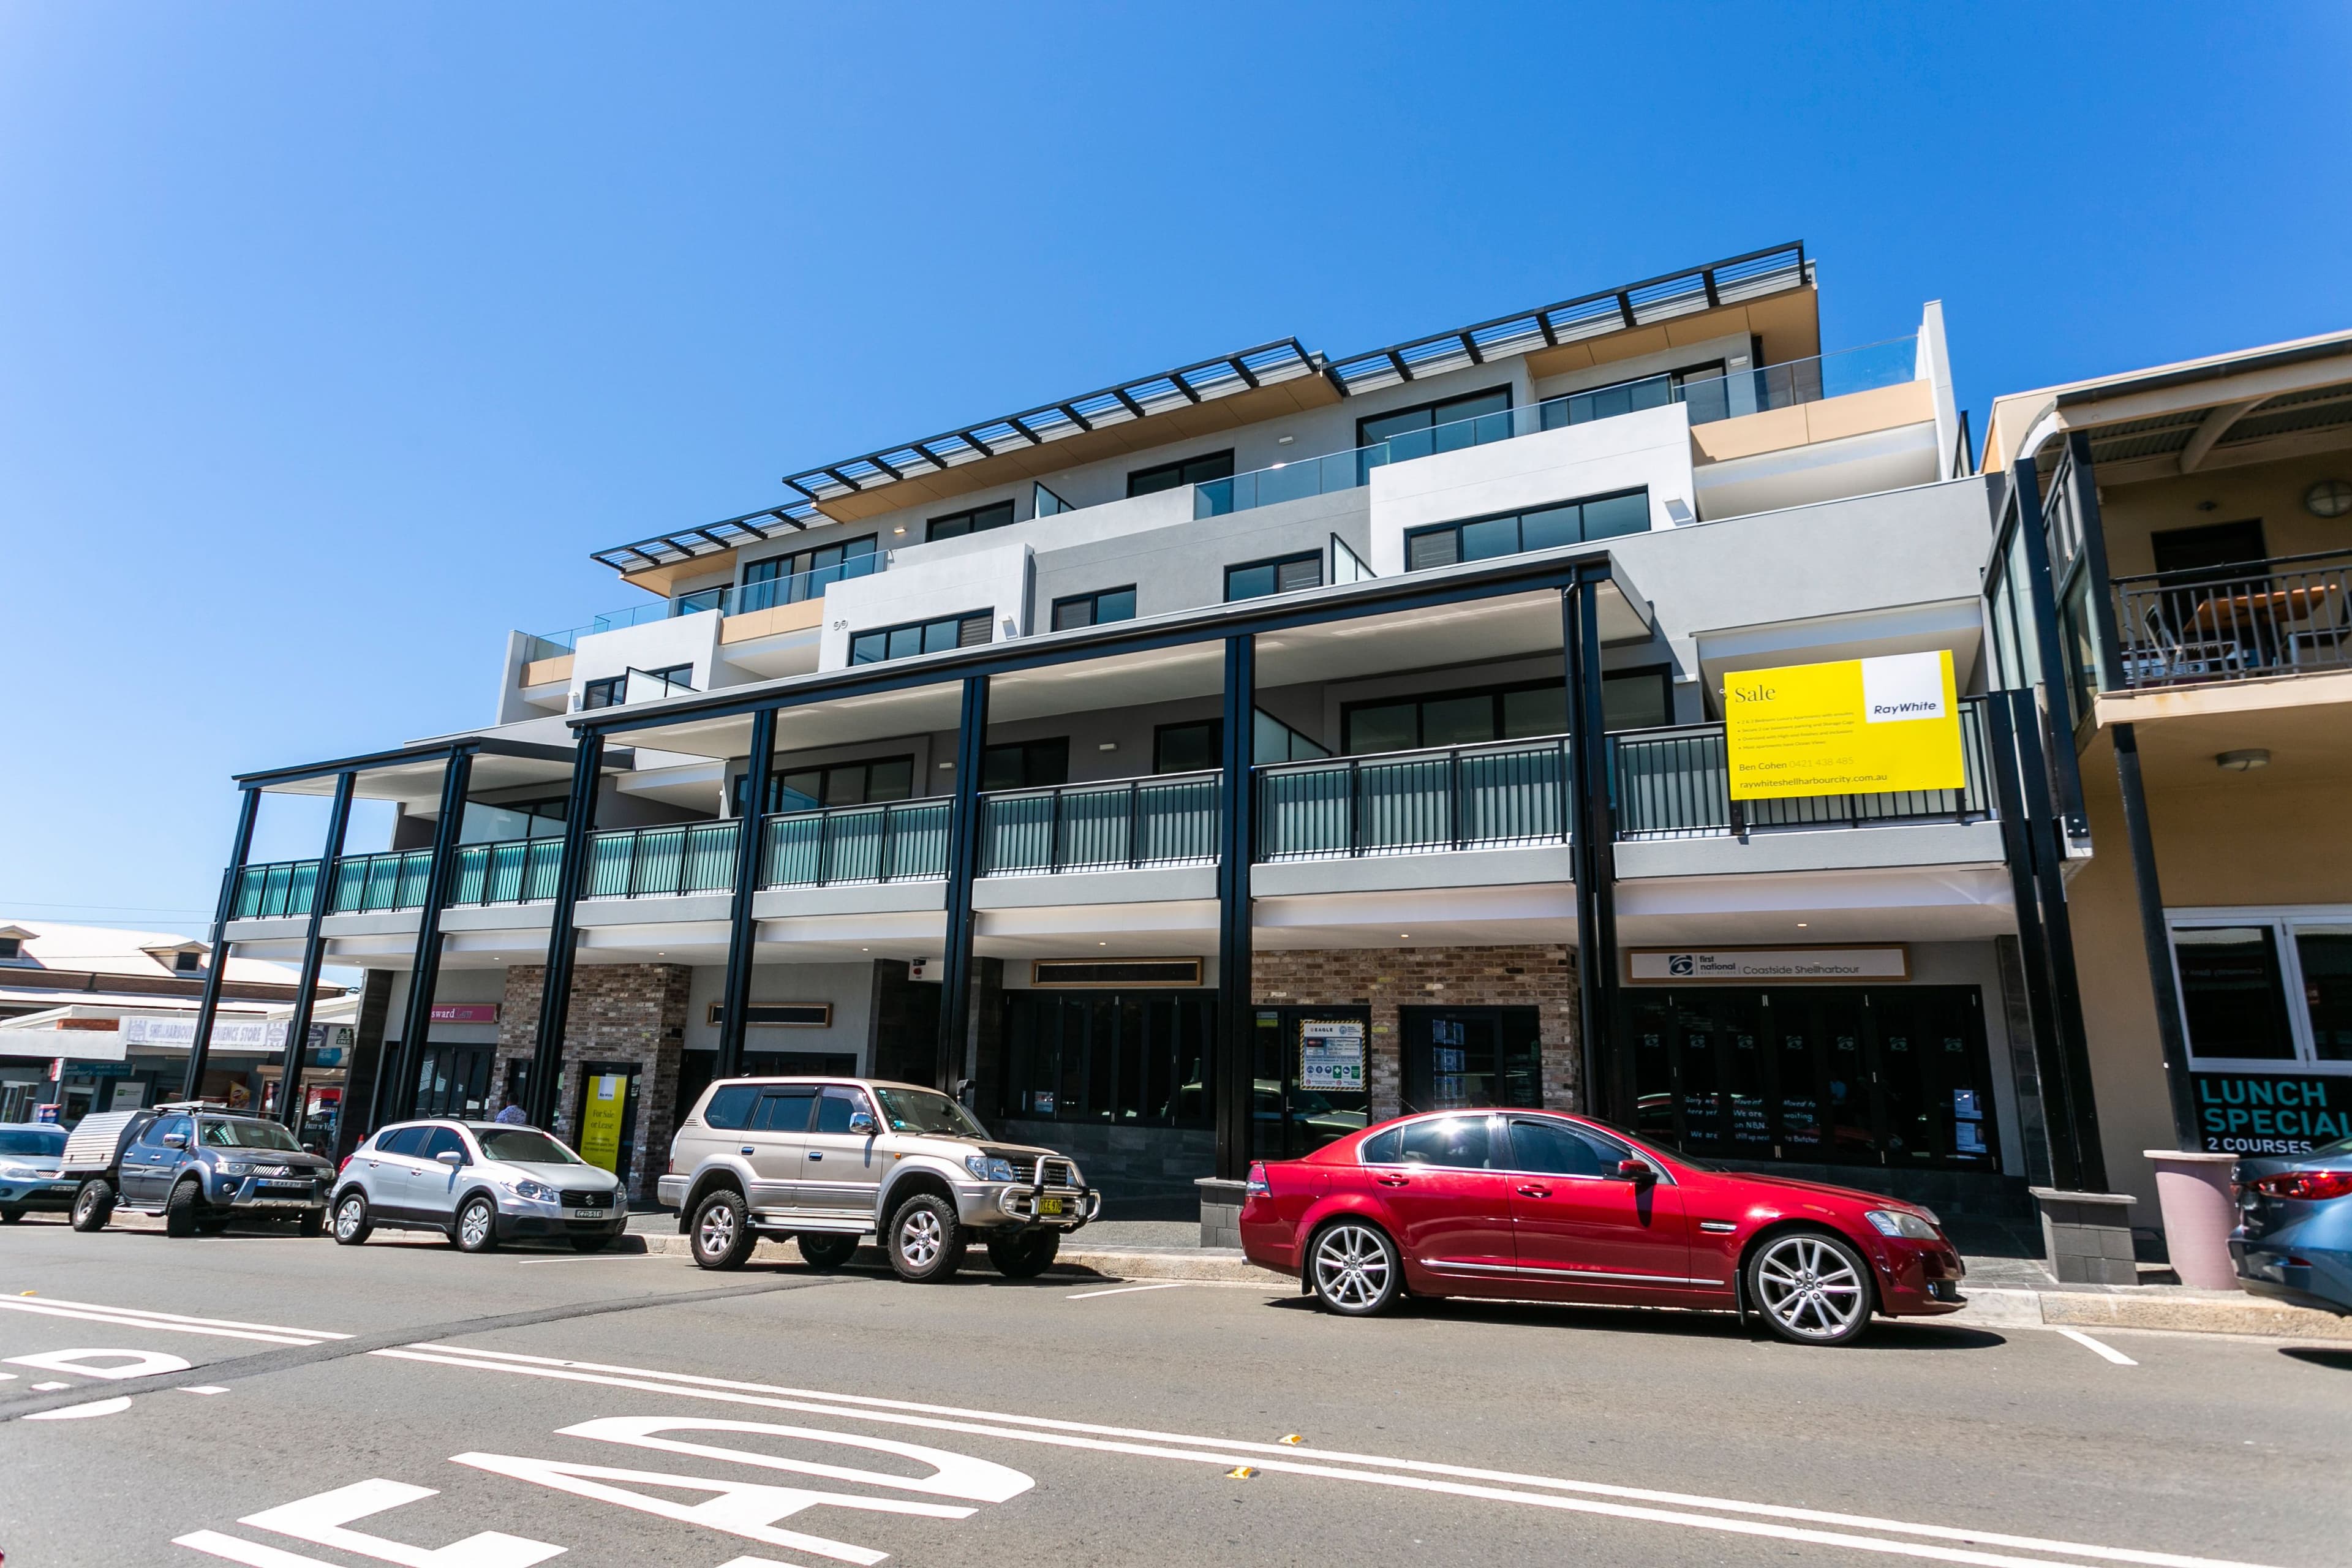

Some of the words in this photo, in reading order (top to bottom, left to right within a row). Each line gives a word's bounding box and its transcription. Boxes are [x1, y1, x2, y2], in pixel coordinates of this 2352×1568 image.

[1735, 684, 1776, 703] Sale
[1789, 760, 1813, 768] 0421
[1836, 756, 1854, 765] 485
[1740, 774, 1888, 788] raywhiteshellharbourcity.com.au
[1743, 965, 1792, 975] Coastside
[1795, 965, 1860, 974] Shellharbour
[2199, 1079, 2327, 1107] LUNCH
[593, 1109, 603, 1118] For
[603, 1109, 614, 1118] Sale
[1783, 1112, 1813, 1123] waiting
[598, 1121, 614, 1129] Lease
[2206, 1137, 2220, 1150] 2
[2223, 1137, 2313, 1155] COURSES
